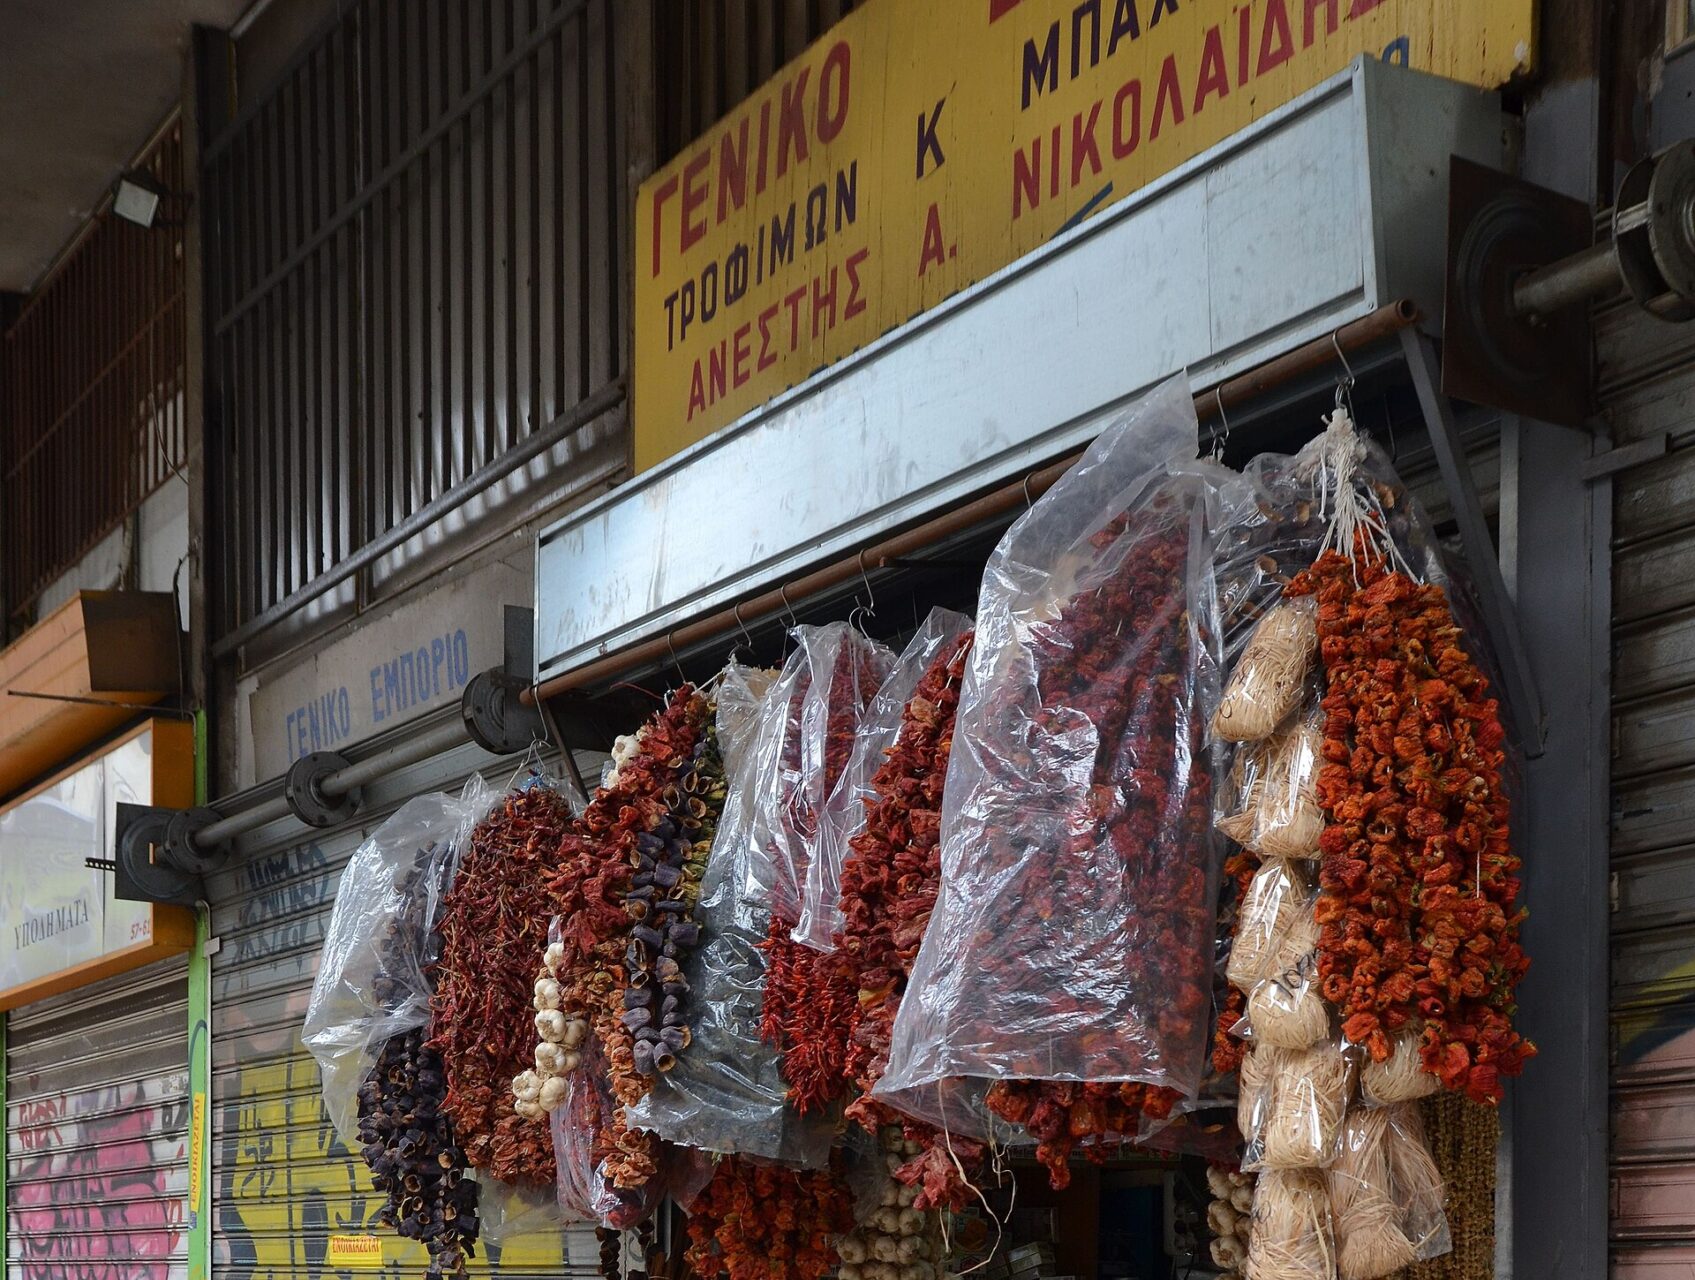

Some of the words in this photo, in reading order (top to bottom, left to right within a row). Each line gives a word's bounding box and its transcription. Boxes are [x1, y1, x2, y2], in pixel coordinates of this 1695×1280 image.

[652, 40, 851, 279] ΓΕΝΙΚΟ
[663, 159, 858, 352] ΤΡΟΦΙΜΩΝ
[916, 97, 946, 180] Κ
[687, 247, 869, 422] ΑΝΕΣΤΗΣ
[918, 202, 957, 277] Α.
[1012, 0, 1387, 220] ΝΙΚΟΛΑΪΔΗ
[286, 686, 350, 764] ΓΕΝΙΚΟ
[370, 628, 469, 722] ΕΜΠΟΡΙΟ
[14, 898, 89, 950] ΥΠΟΔΗΜΑΤΑ
[190, 1098, 201, 1203] ΕΝΟΙΚΙΑΖΕΤΑΙ
[332, 1237, 380, 1253] ΕΝΟΙΚΙΑΖΕΤΑΙ
